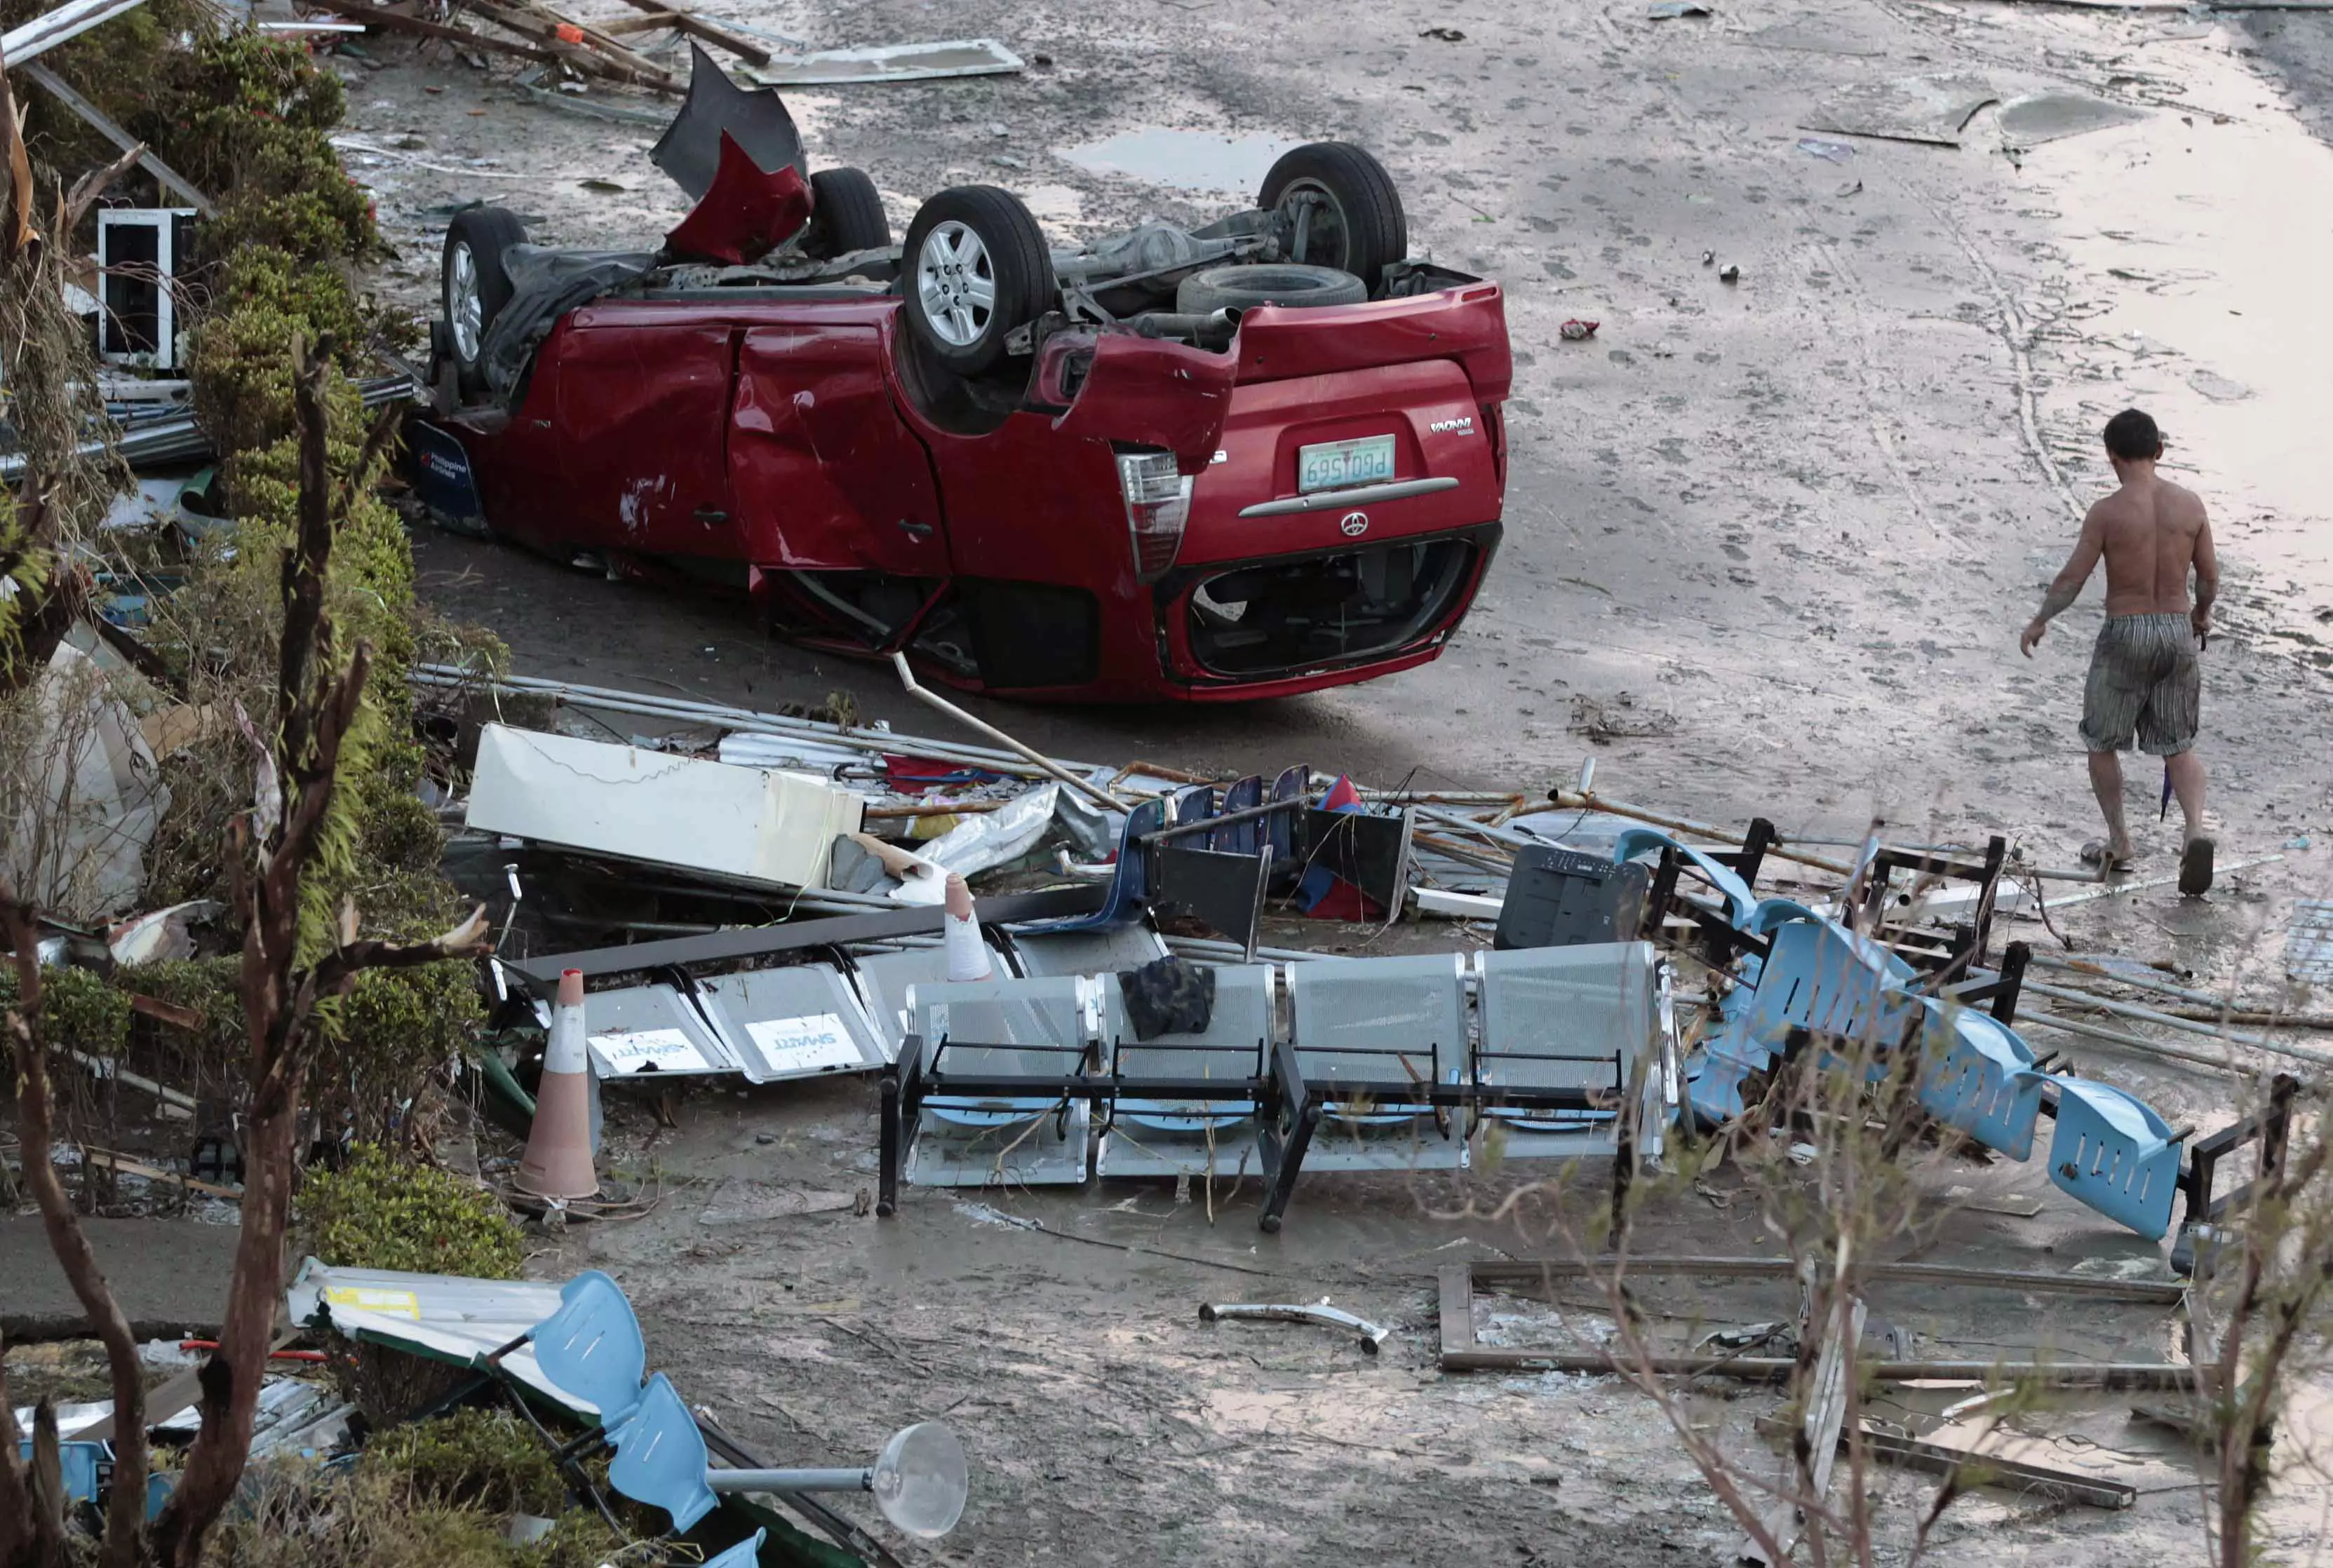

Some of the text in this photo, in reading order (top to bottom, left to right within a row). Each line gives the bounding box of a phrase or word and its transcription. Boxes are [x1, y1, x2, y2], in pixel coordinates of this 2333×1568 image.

[1430, 417, 1471, 433] INNOVA
[1307, 457, 1342, 487] 569
[774, 1033, 837, 1050] SMART
